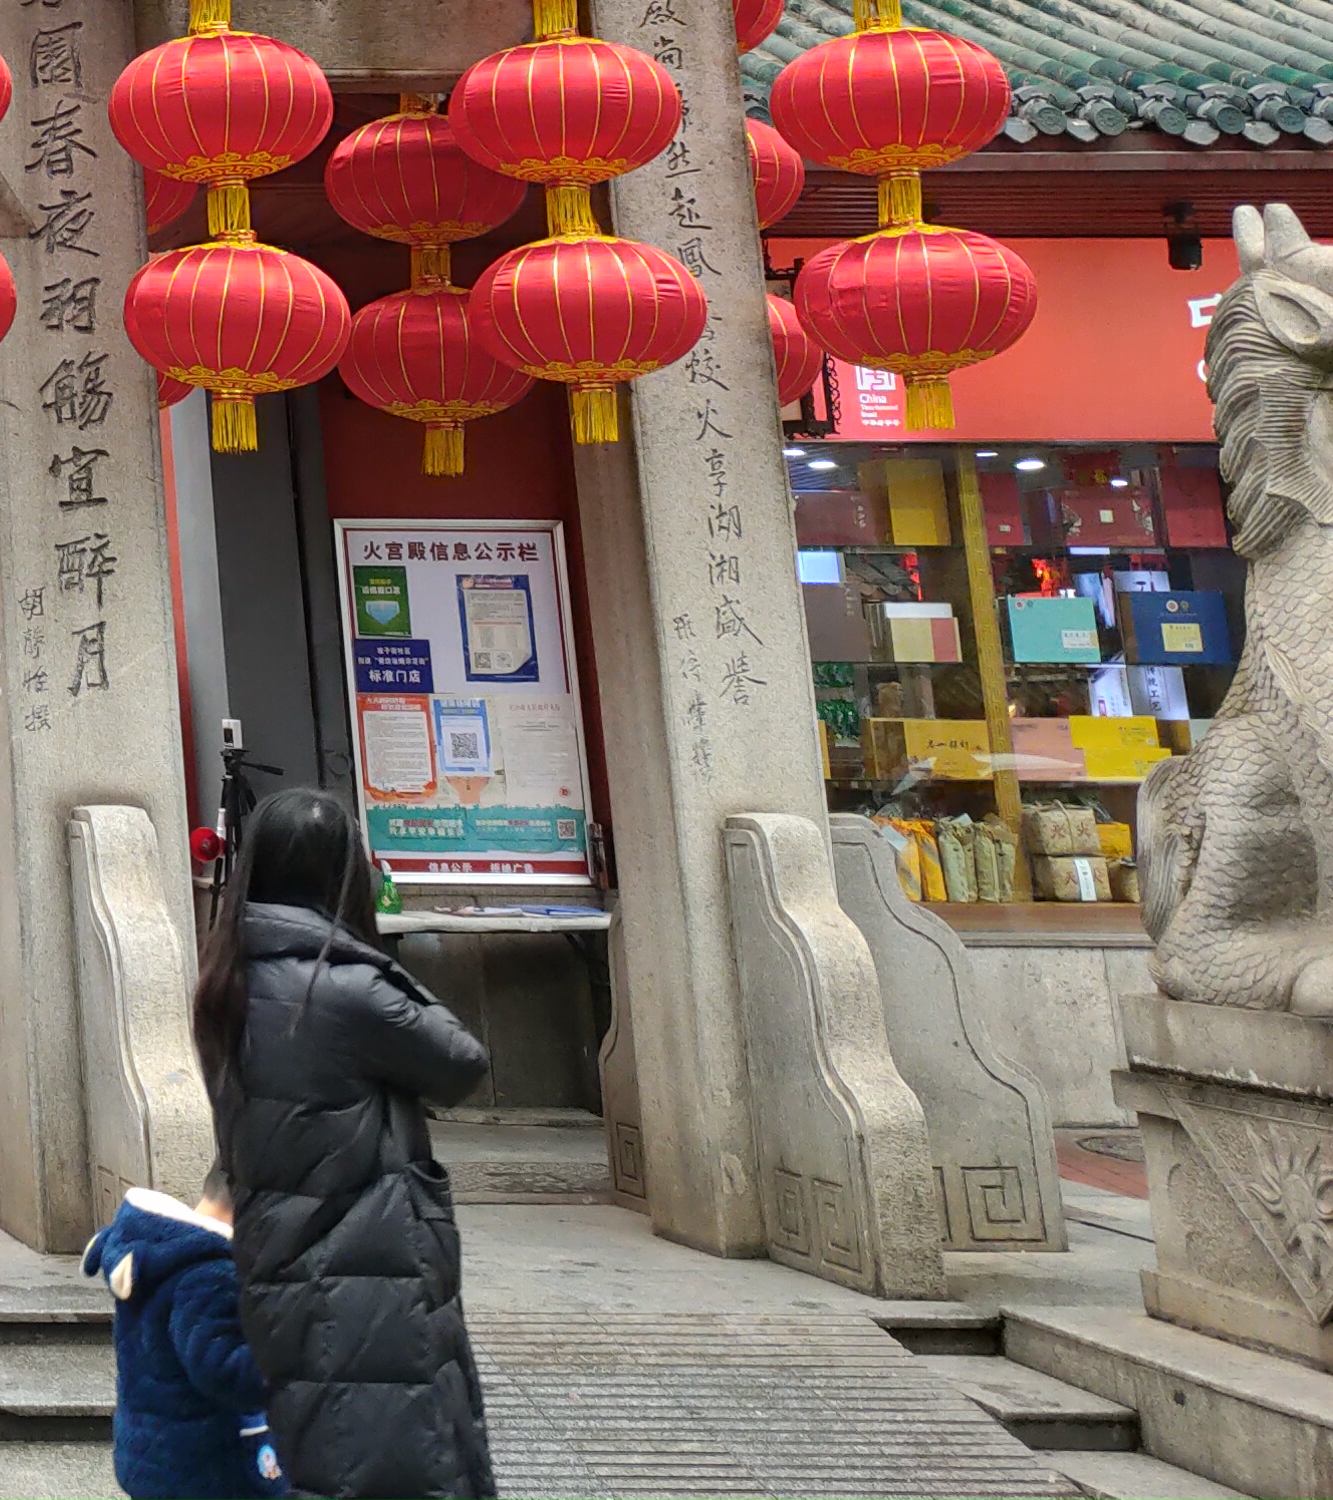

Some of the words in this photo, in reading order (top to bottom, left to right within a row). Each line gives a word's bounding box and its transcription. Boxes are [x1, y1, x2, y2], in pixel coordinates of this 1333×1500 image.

[363, 540, 540, 563] 火宫殿信息公示栏
[368, 669, 422, 684] 标准门店
[428, 862, 473, 874] 信息公示
